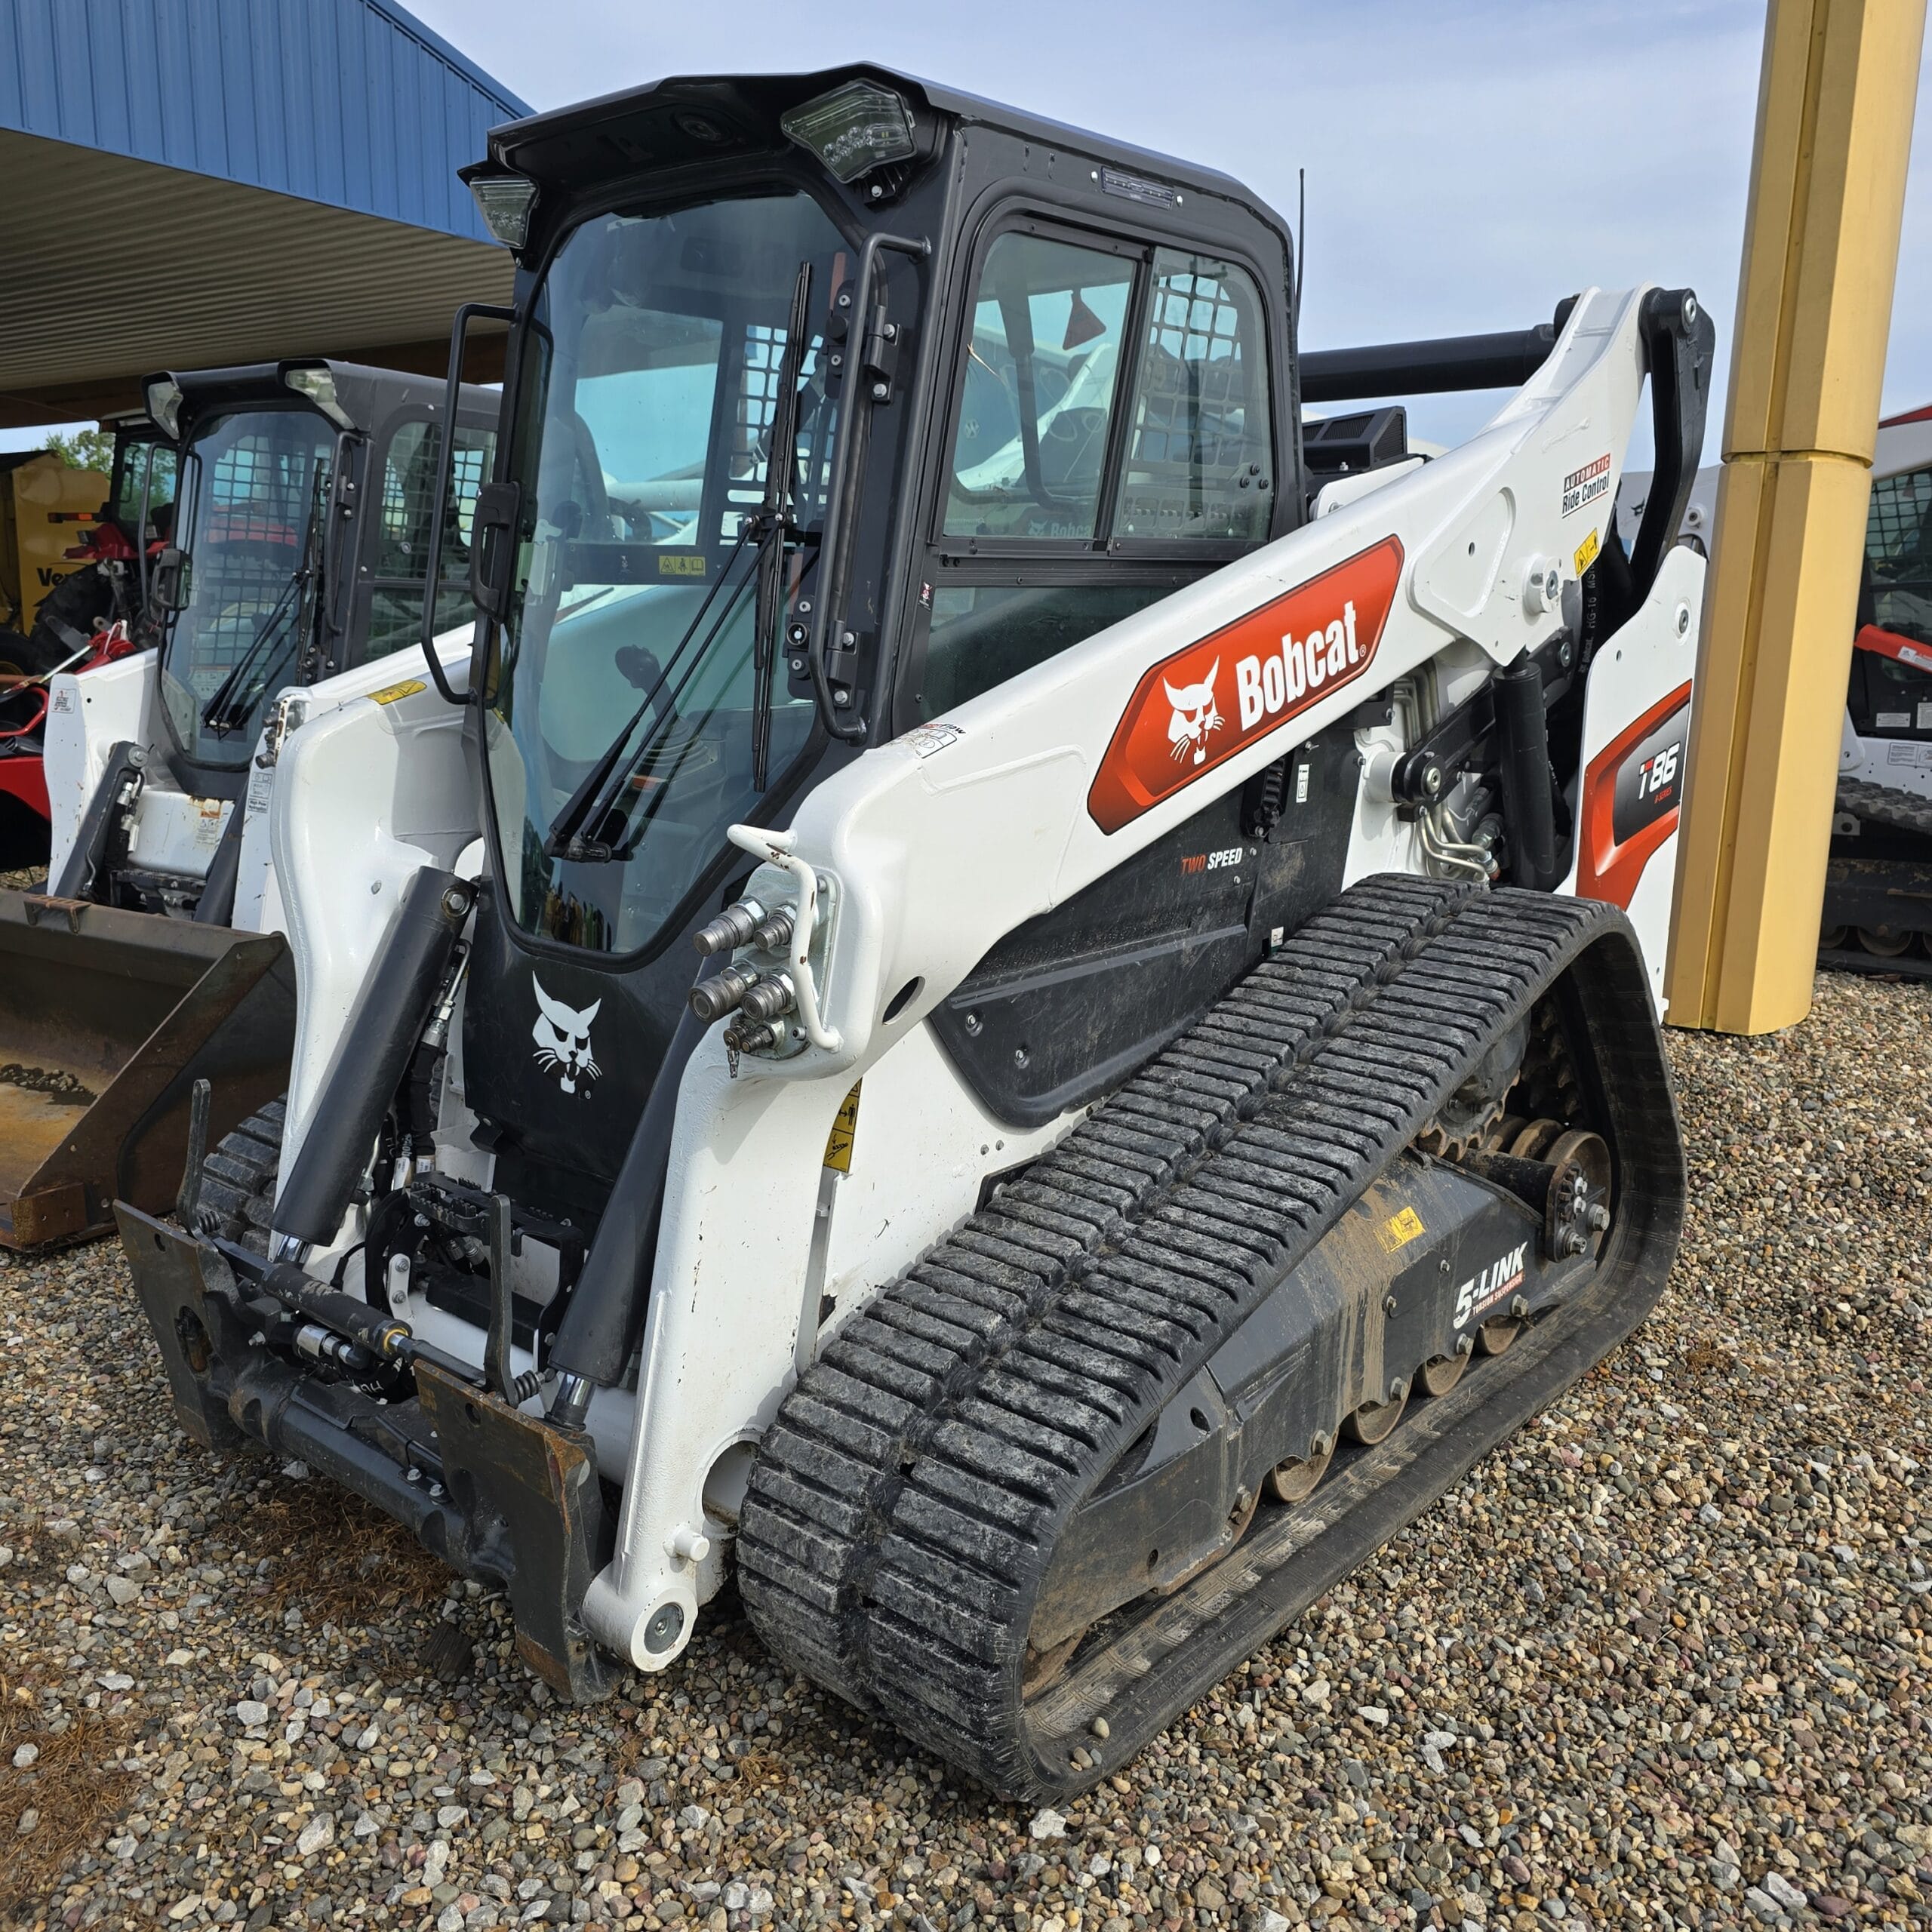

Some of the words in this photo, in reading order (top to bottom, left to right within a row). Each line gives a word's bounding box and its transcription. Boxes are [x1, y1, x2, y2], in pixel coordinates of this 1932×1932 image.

[1562, 491, 1580, 514] Ride
[1582, 471, 1609, 502] Control
[1564, 455, 1609, 491] AUTOMATIC
[1235, 600, 1359, 731] Bobcat
[1638, 742, 1680, 800] T86
[1182, 854, 1206, 876] TWO
[1208, 848, 1242, 870] SPEED
[1453, 1241, 1527, 1329] 5-LINK
[1472, 1294, 1494, 1316] TORSION
